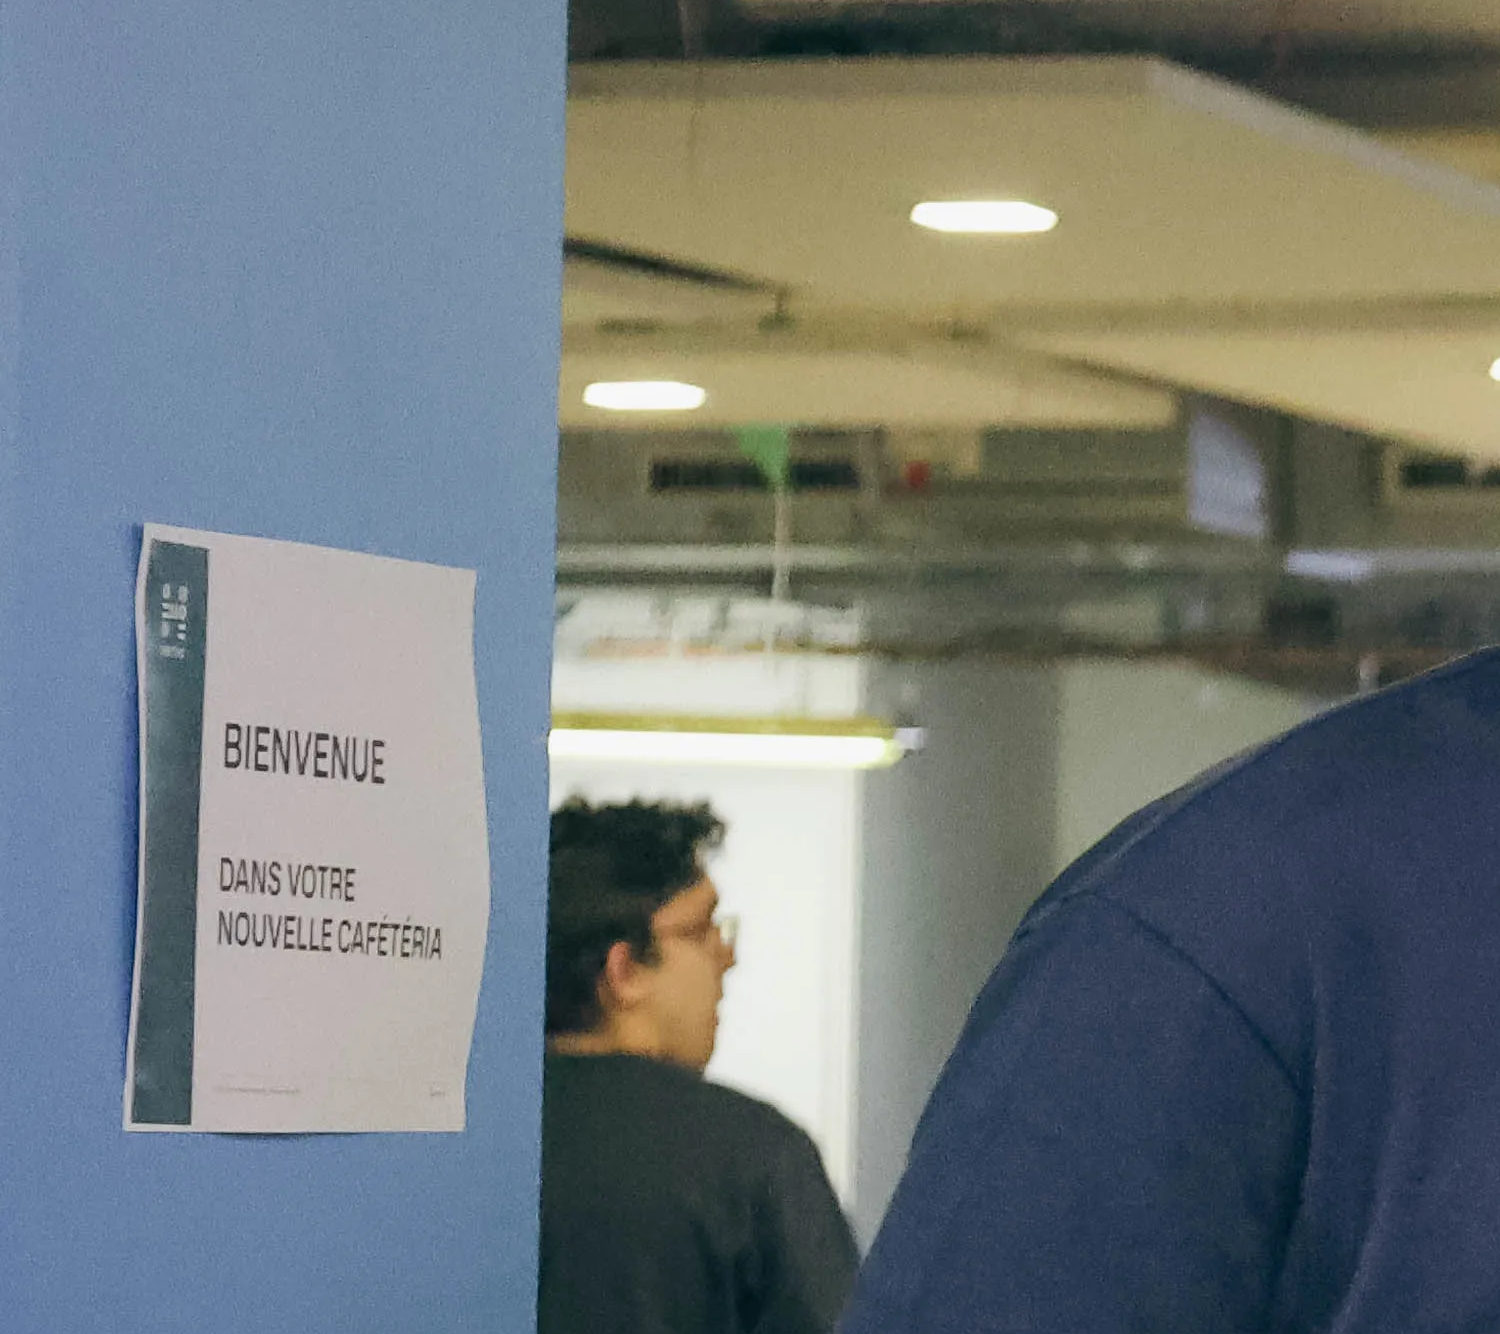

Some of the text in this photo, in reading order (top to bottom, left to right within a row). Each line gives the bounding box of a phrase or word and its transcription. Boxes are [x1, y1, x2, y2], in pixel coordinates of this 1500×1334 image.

[224, 723, 385, 784] BIENVENUE
[219, 857, 356, 901] DANS VOTRE
[218, 911, 442, 960] NOUVELLE CAFÉTÉRIA
